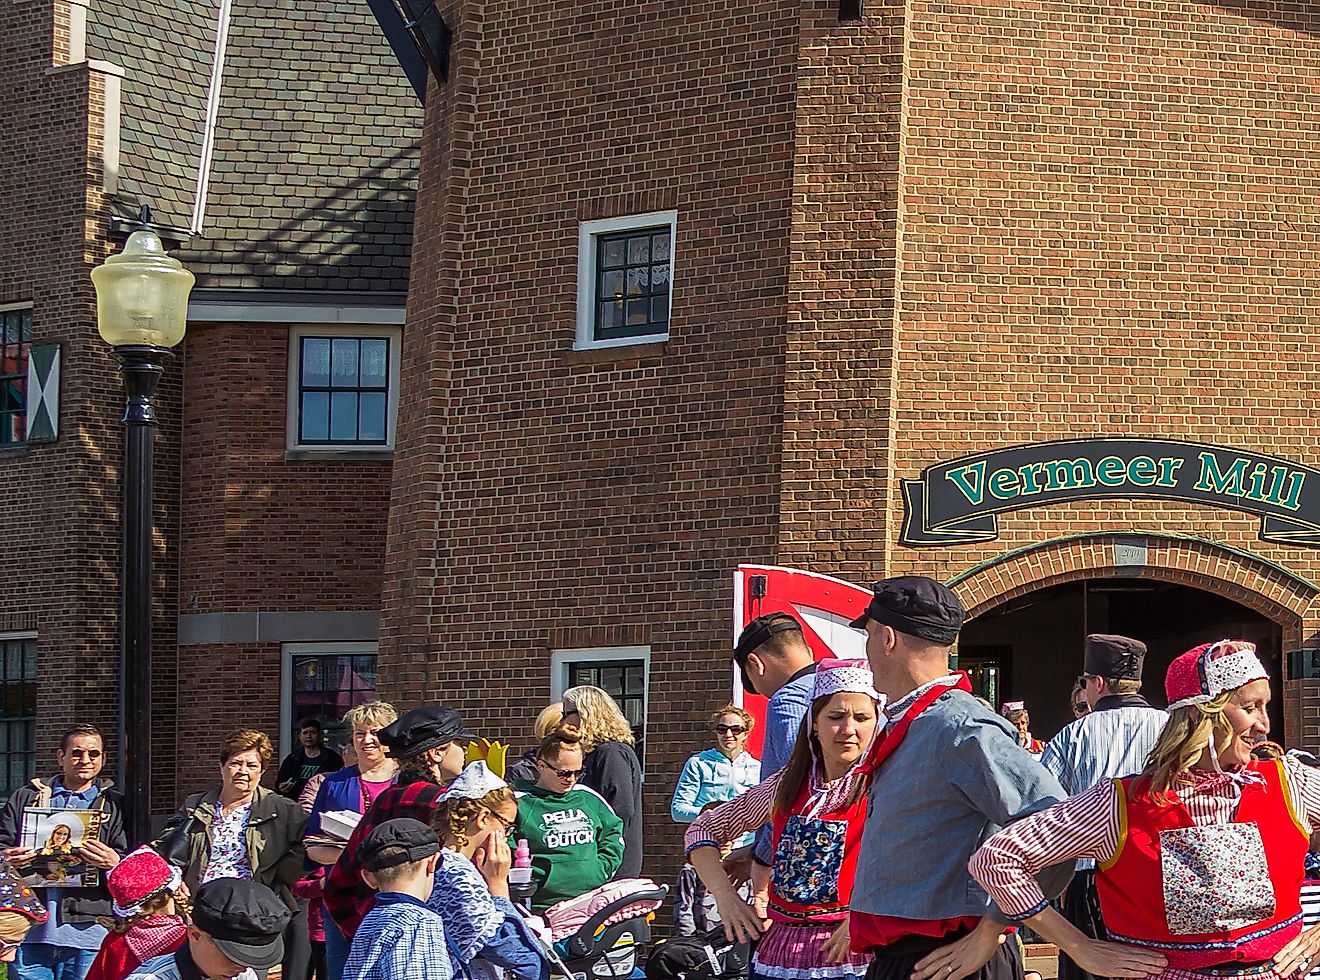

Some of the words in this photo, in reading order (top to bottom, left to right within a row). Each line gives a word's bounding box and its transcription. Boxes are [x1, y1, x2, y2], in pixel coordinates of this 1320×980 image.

[945, 455, 1185, 506] Vermeer
[1193, 451, 1307, 511] Mill
[541, 809, 589, 825] PELLA
[547, 830, 595, 849] DUTCH
